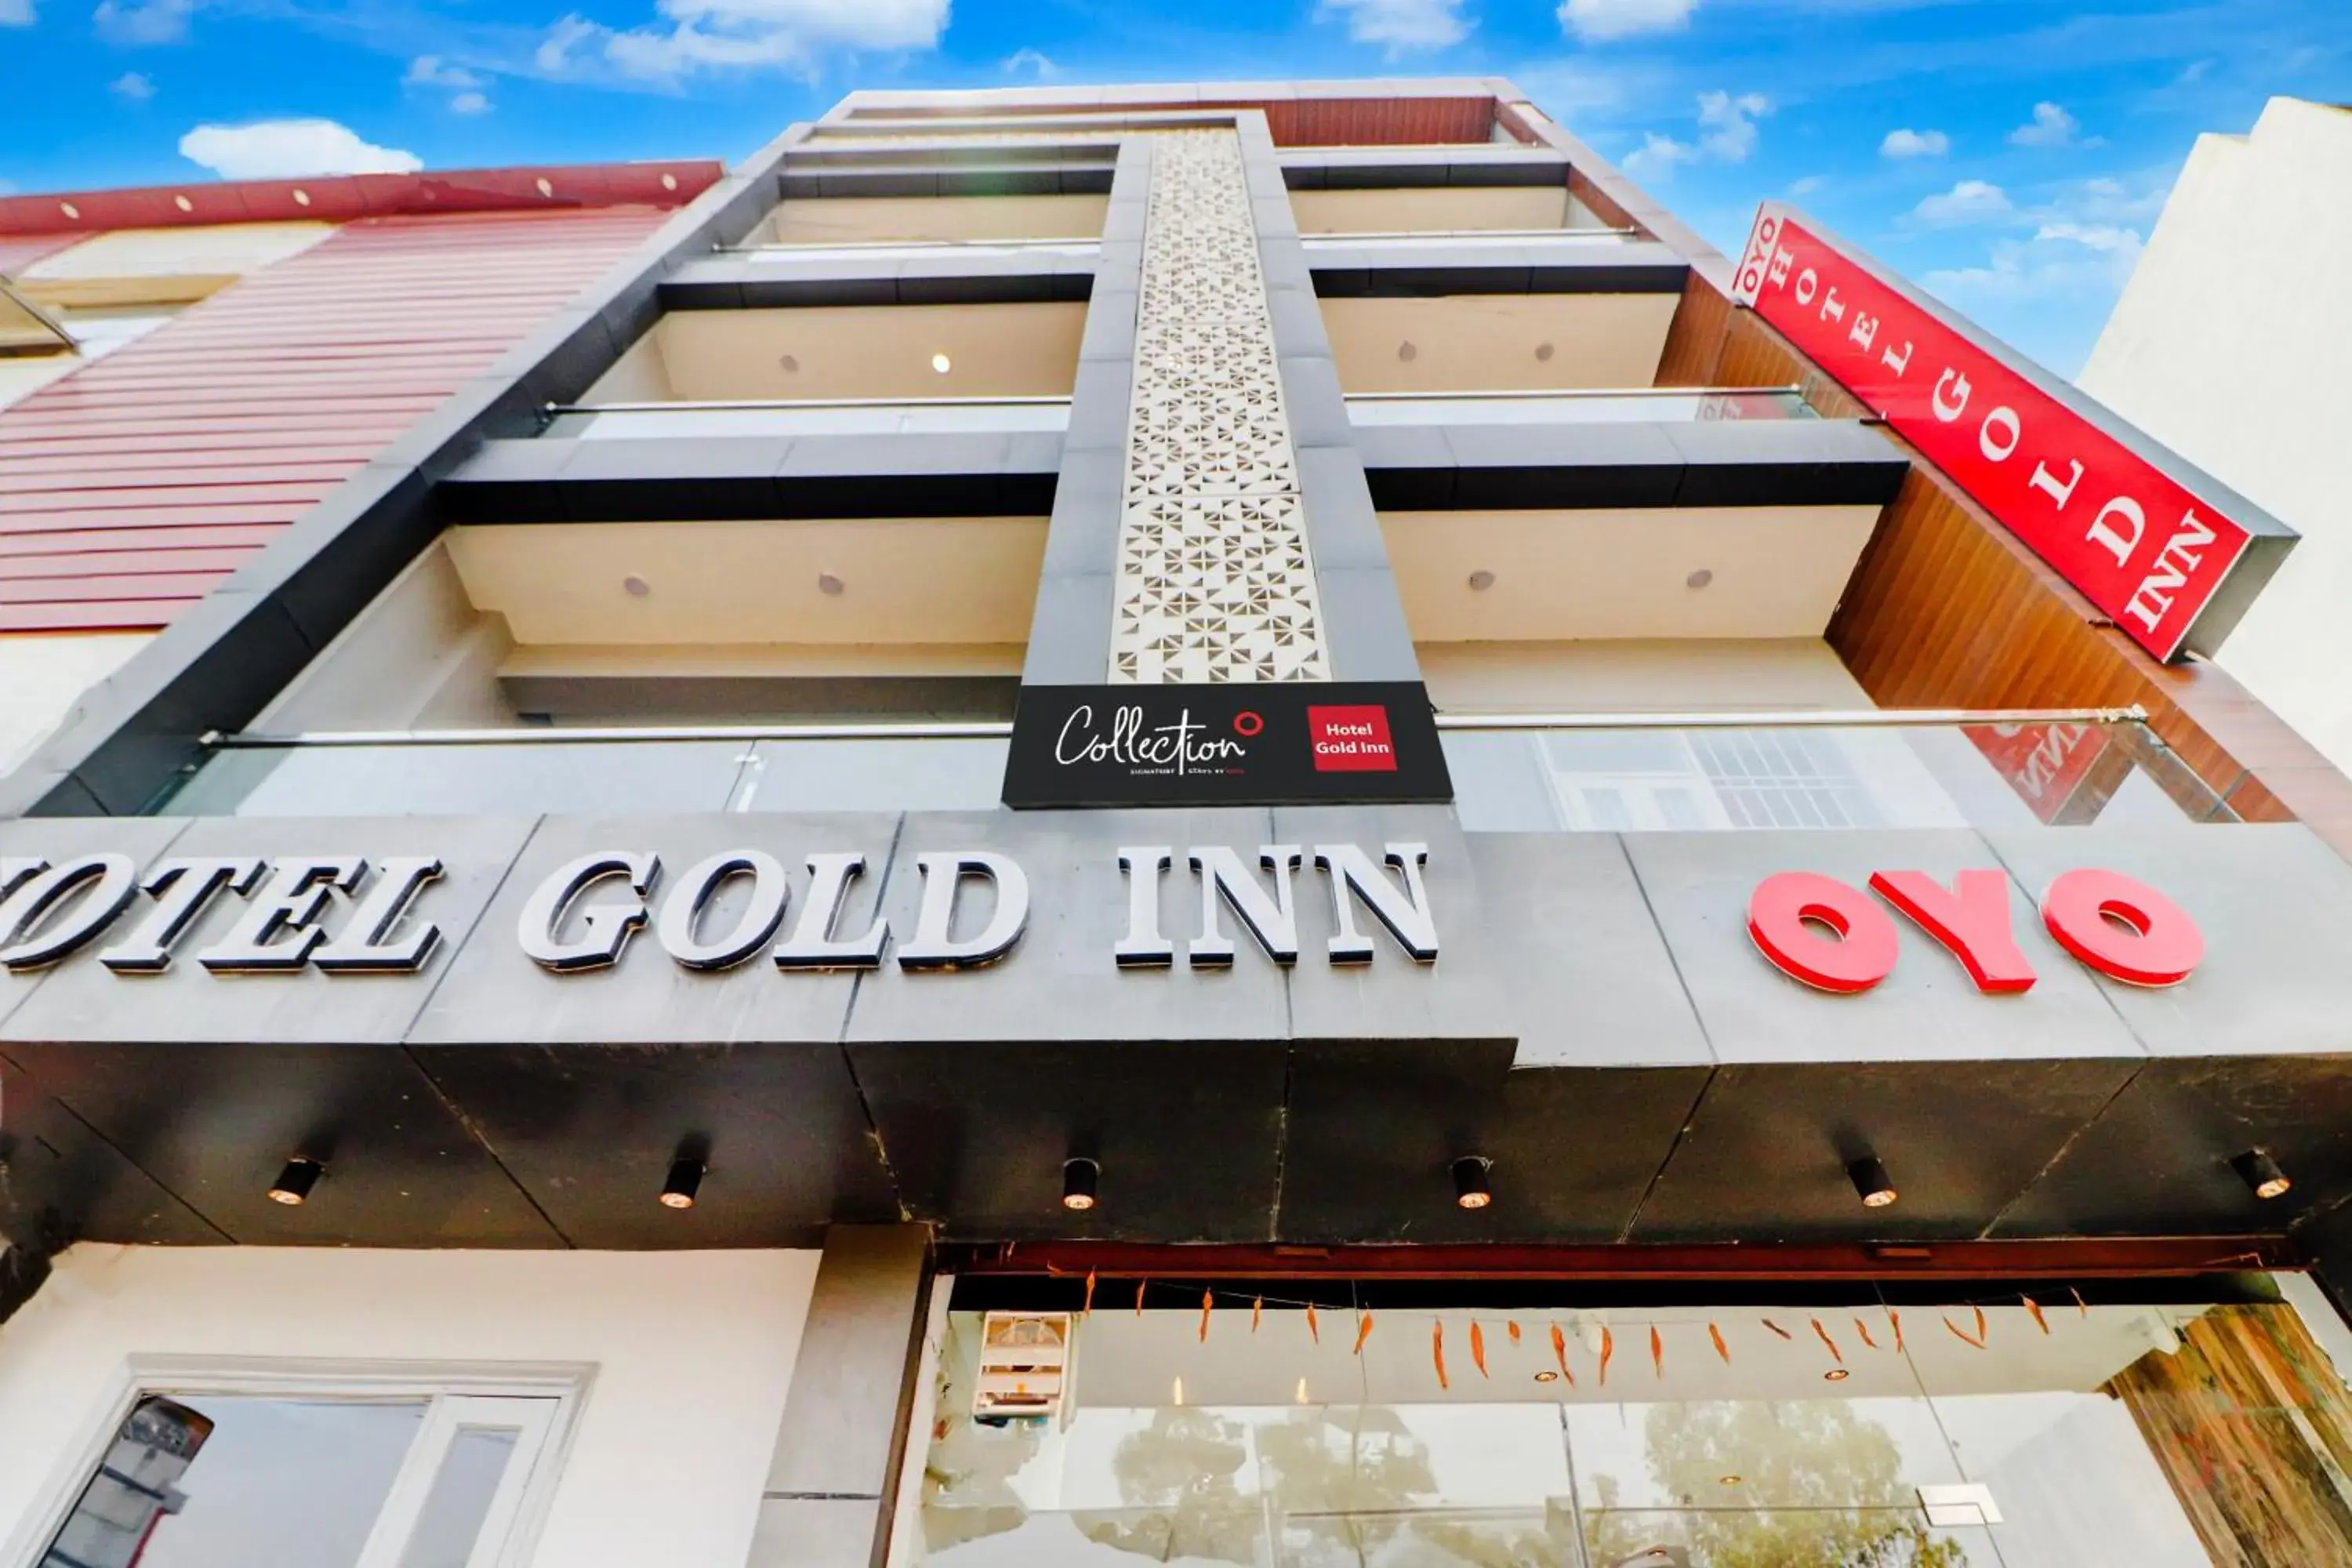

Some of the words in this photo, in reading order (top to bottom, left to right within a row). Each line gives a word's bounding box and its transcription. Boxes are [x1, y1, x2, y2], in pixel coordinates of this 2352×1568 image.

[1742, 216, 1776, 294] OYO
[1766, 244, 1914, 377] HOTEL
[1931, 367, 2146, 568] GOLD
[2124, 508, 2218, 633] INN
[1054, 705, 1247, 775] Collection
[1316, 741, 1357, 753] Gold
[1360, 741, 1390, 753] Inn
[1325, 722, 1374, 736] Hotel
[517, 849, 1030, 974] GOLD
[1114, 842, 1439, 967] INN
[1745, 868, 2206, 993] OYO
